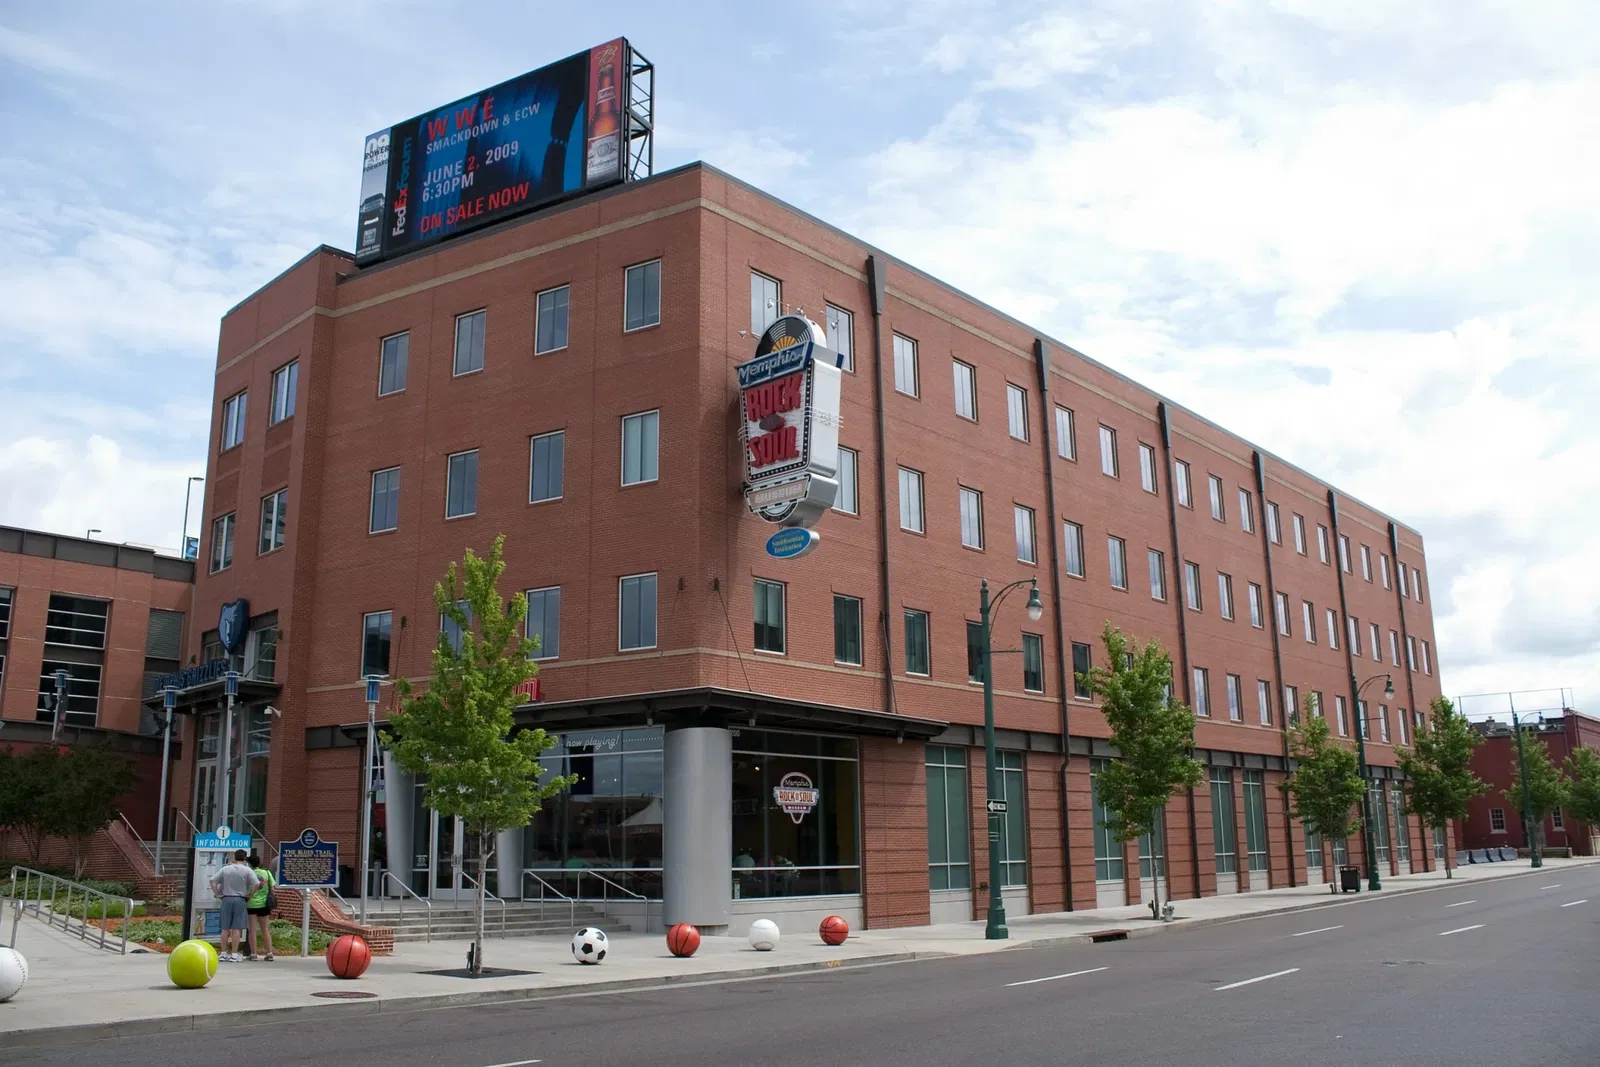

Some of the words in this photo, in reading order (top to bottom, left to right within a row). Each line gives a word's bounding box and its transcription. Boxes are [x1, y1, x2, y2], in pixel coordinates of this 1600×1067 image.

[425, 118, 499, 155] SMACKDOWN
[502, 114, 511, 126] &
[514, 102, 540, 121] ECW
[365, 144, 391, 160] POWER
[423, 160, 463, 187] JUNE
[485, 140, 519, 165] 2009
[422, 172, 474, 202] 6:30PM
[420, 212, 443, 234] ON
[446, 197, 485, 225] SALE
[488, 182, 529, 211] NOW
[739, 346, 804, 384] Memphis
[745, 372, 803, 422] ROCK
[748, 425, 800, 468] SOUL
[754, 483, 803, 503] MUSEUM
[566, 739, 582, 748] now
[583, 734, 620, 751] playing!
[779, 791, 795, 802] ROCK
[799, 792, 813, 803] SOUL
[196, 839, 249, 848] INFORMATION
